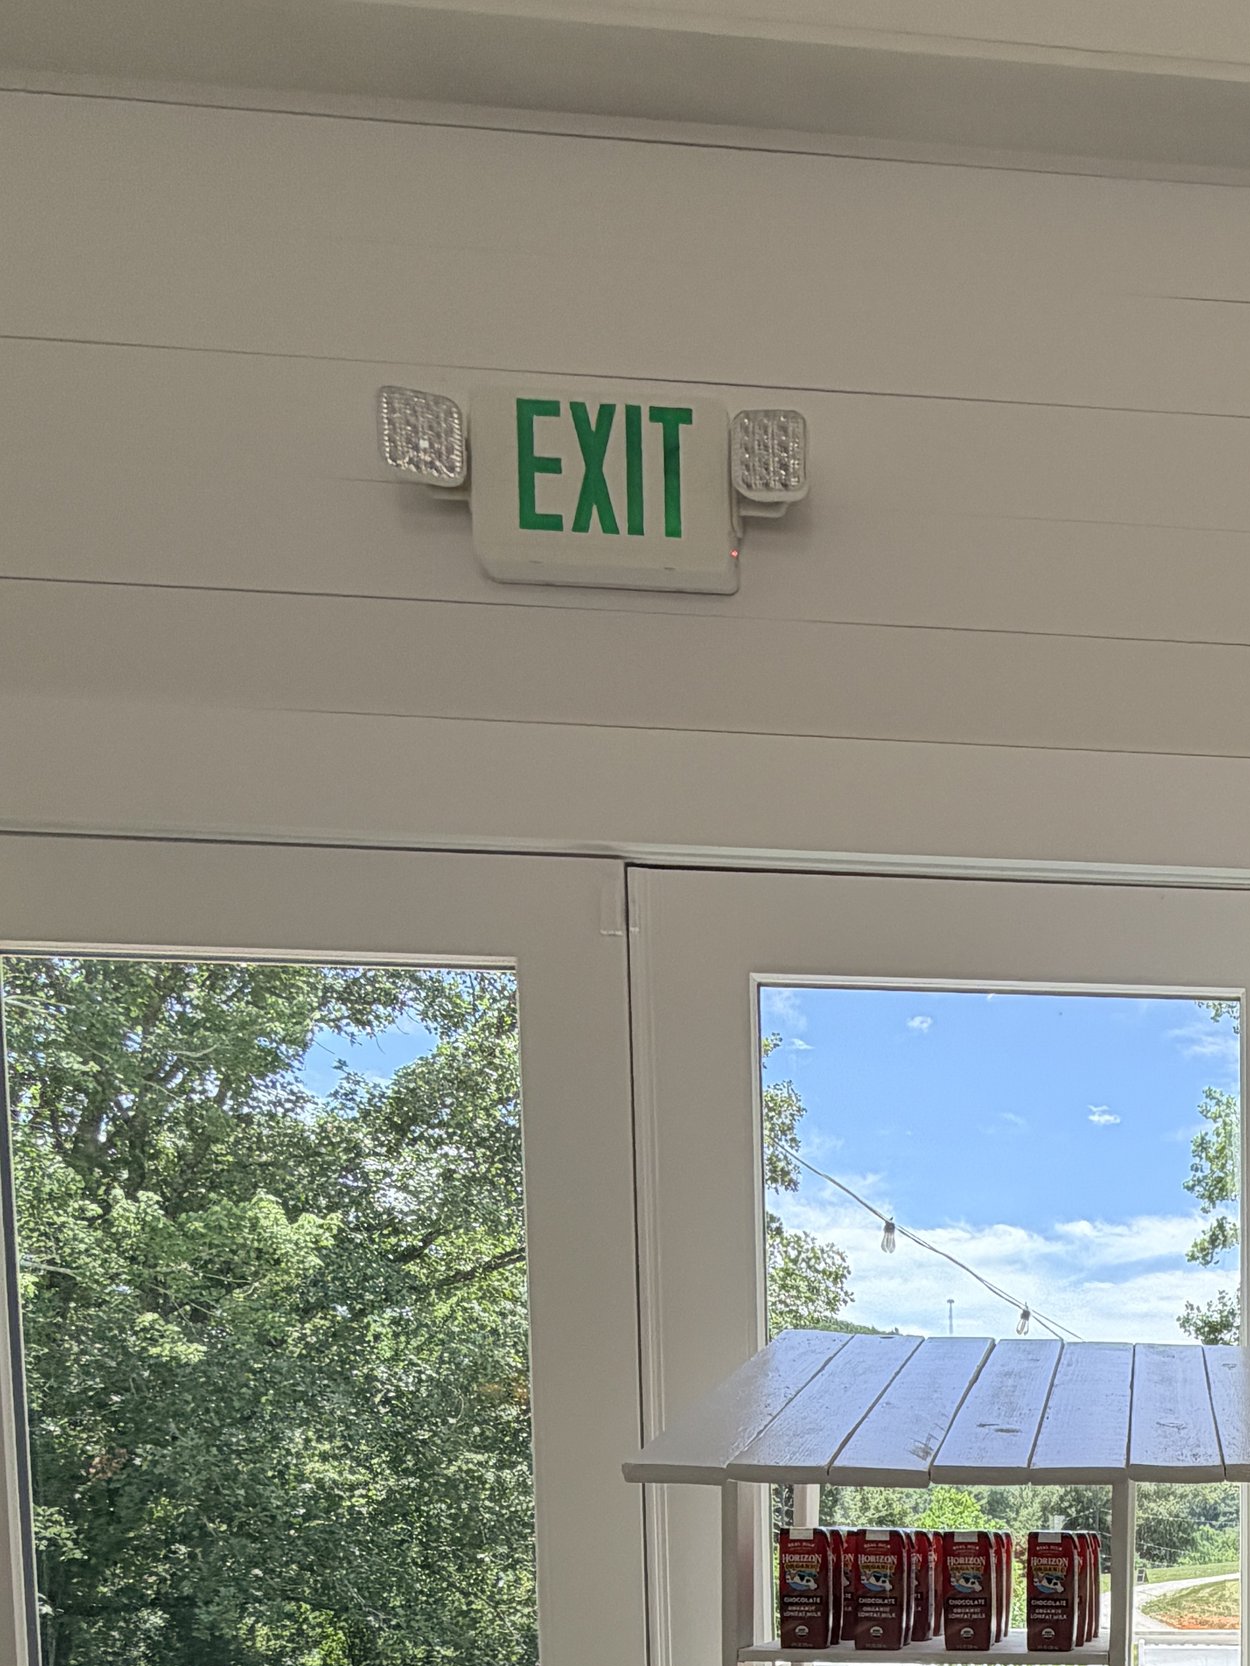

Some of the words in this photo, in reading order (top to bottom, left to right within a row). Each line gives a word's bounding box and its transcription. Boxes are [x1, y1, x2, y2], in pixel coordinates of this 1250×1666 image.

[516, 398, 693, 538] EXIT
[783, 1554, 822, 1563] HORIZON
[858, 1555, 897, 1564] HORIZON
[947, 1557, 985, 1566] HORIZON
[1031, 1557, 1068, 1566] HORIZON
